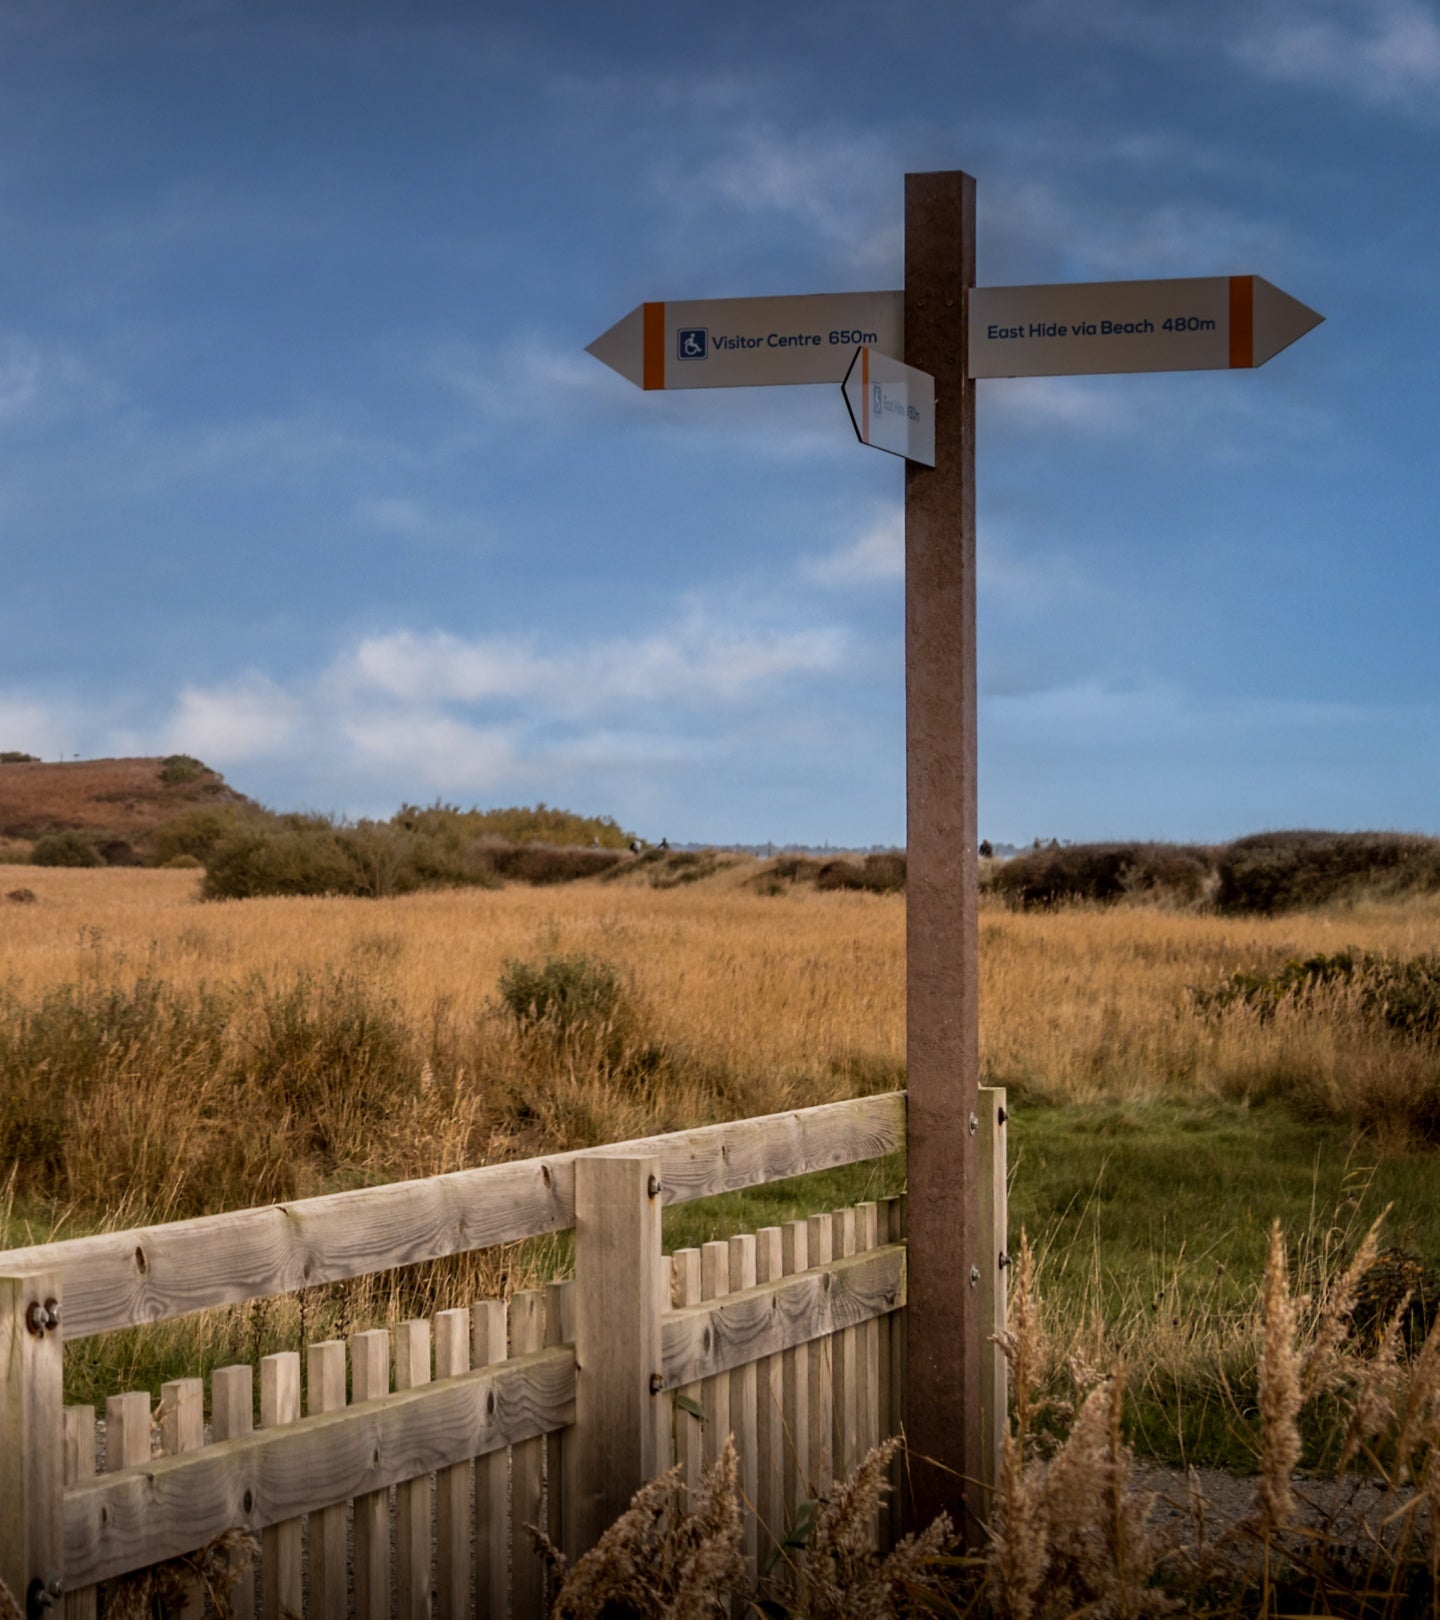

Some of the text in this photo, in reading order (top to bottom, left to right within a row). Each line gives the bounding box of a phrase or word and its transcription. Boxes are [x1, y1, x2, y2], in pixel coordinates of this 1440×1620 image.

[987, 317, 1216, 340] East Hide via Beach 480m
[712, 330, 878, 350] Visitor Centre 650m
